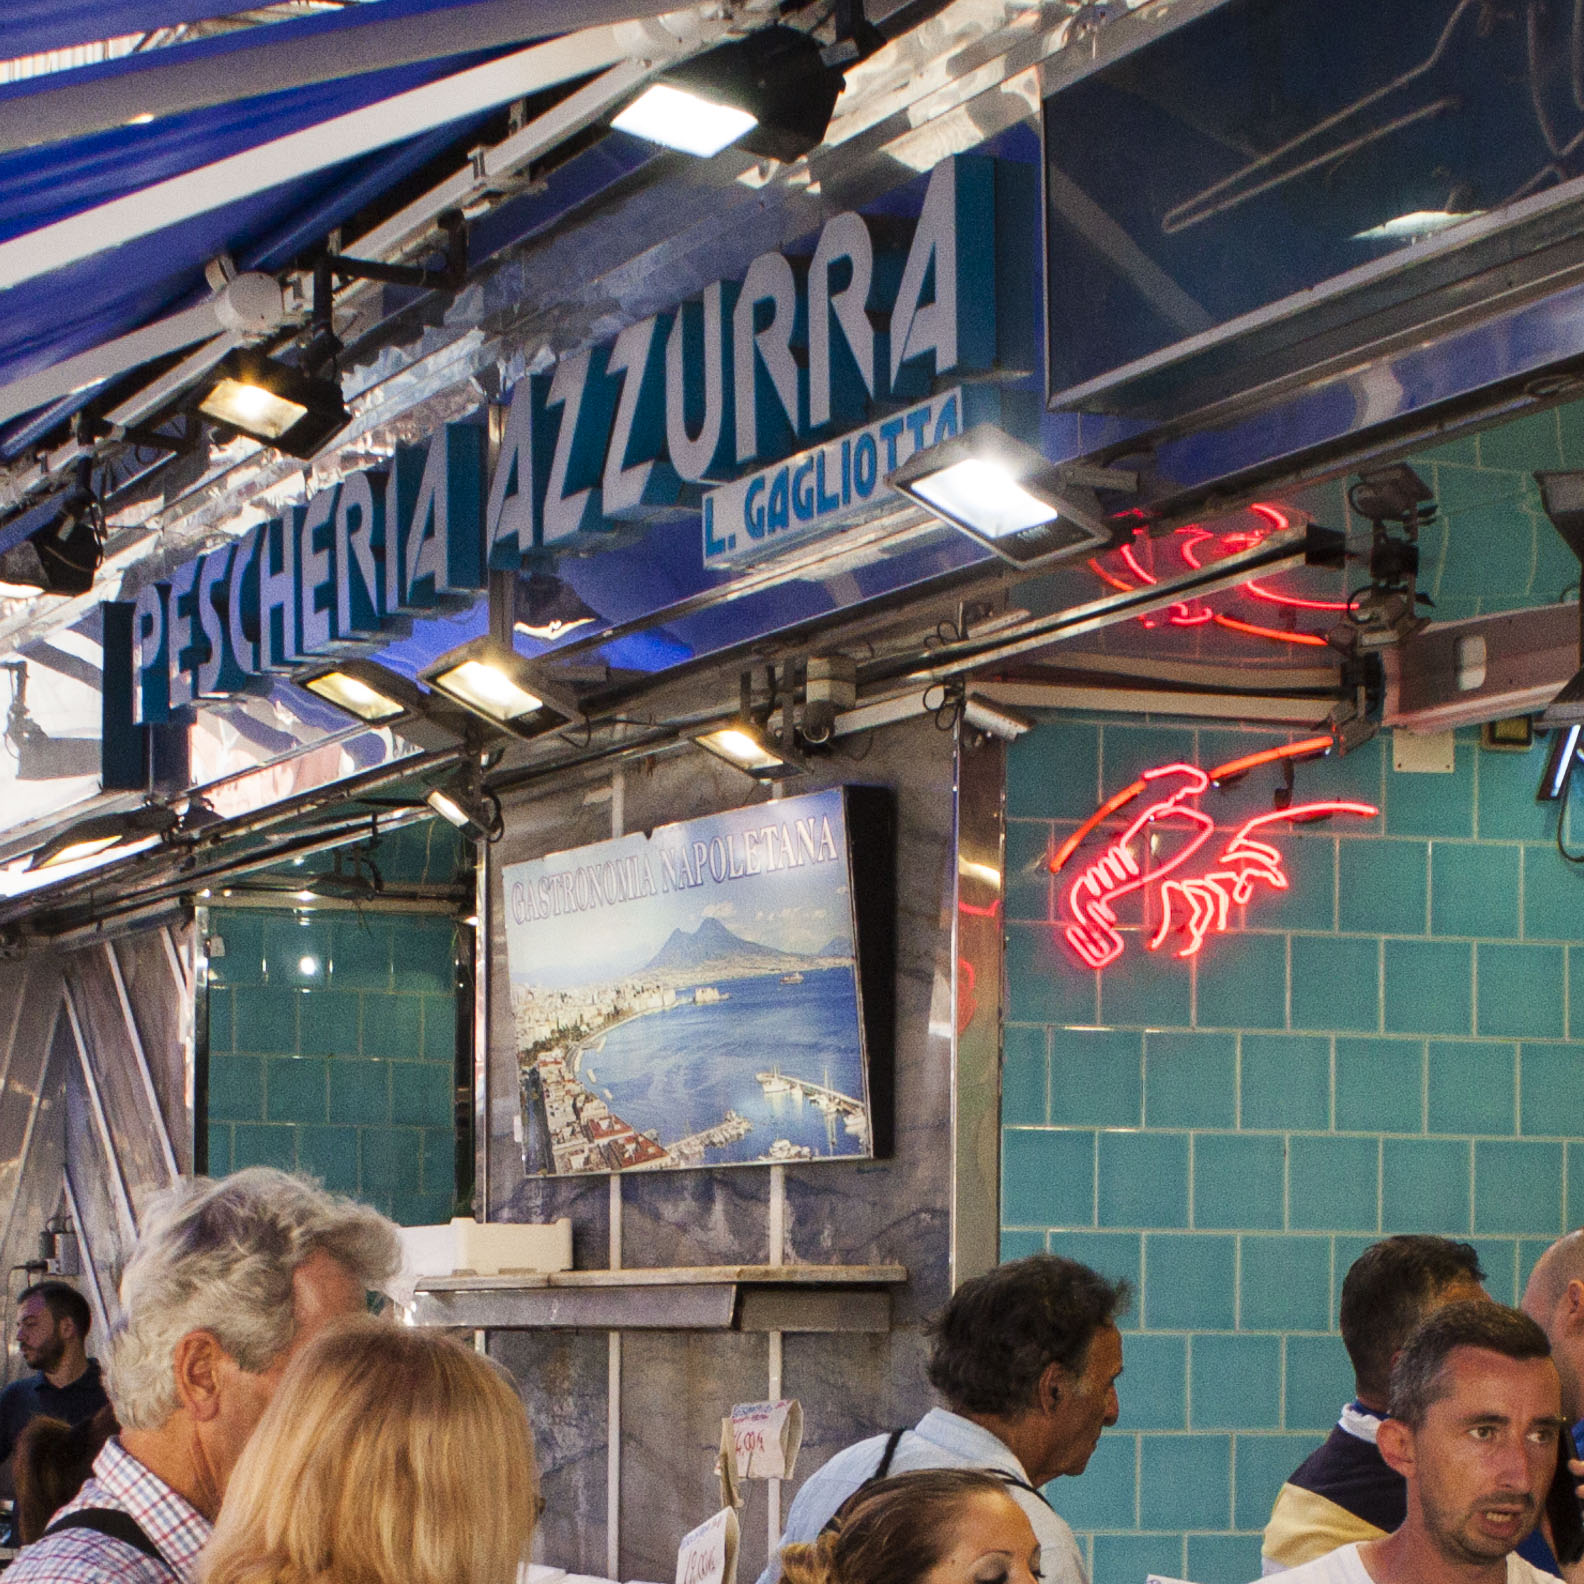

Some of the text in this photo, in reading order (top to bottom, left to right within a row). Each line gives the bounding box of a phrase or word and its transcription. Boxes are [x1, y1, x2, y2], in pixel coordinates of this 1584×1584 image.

[132, 157, 958, 725] PESCHERIA AZZURRA
[705, 497, 736, 558] L.
[511, 816, 839, 925] GASTRONOMIA NAPOLETANA
